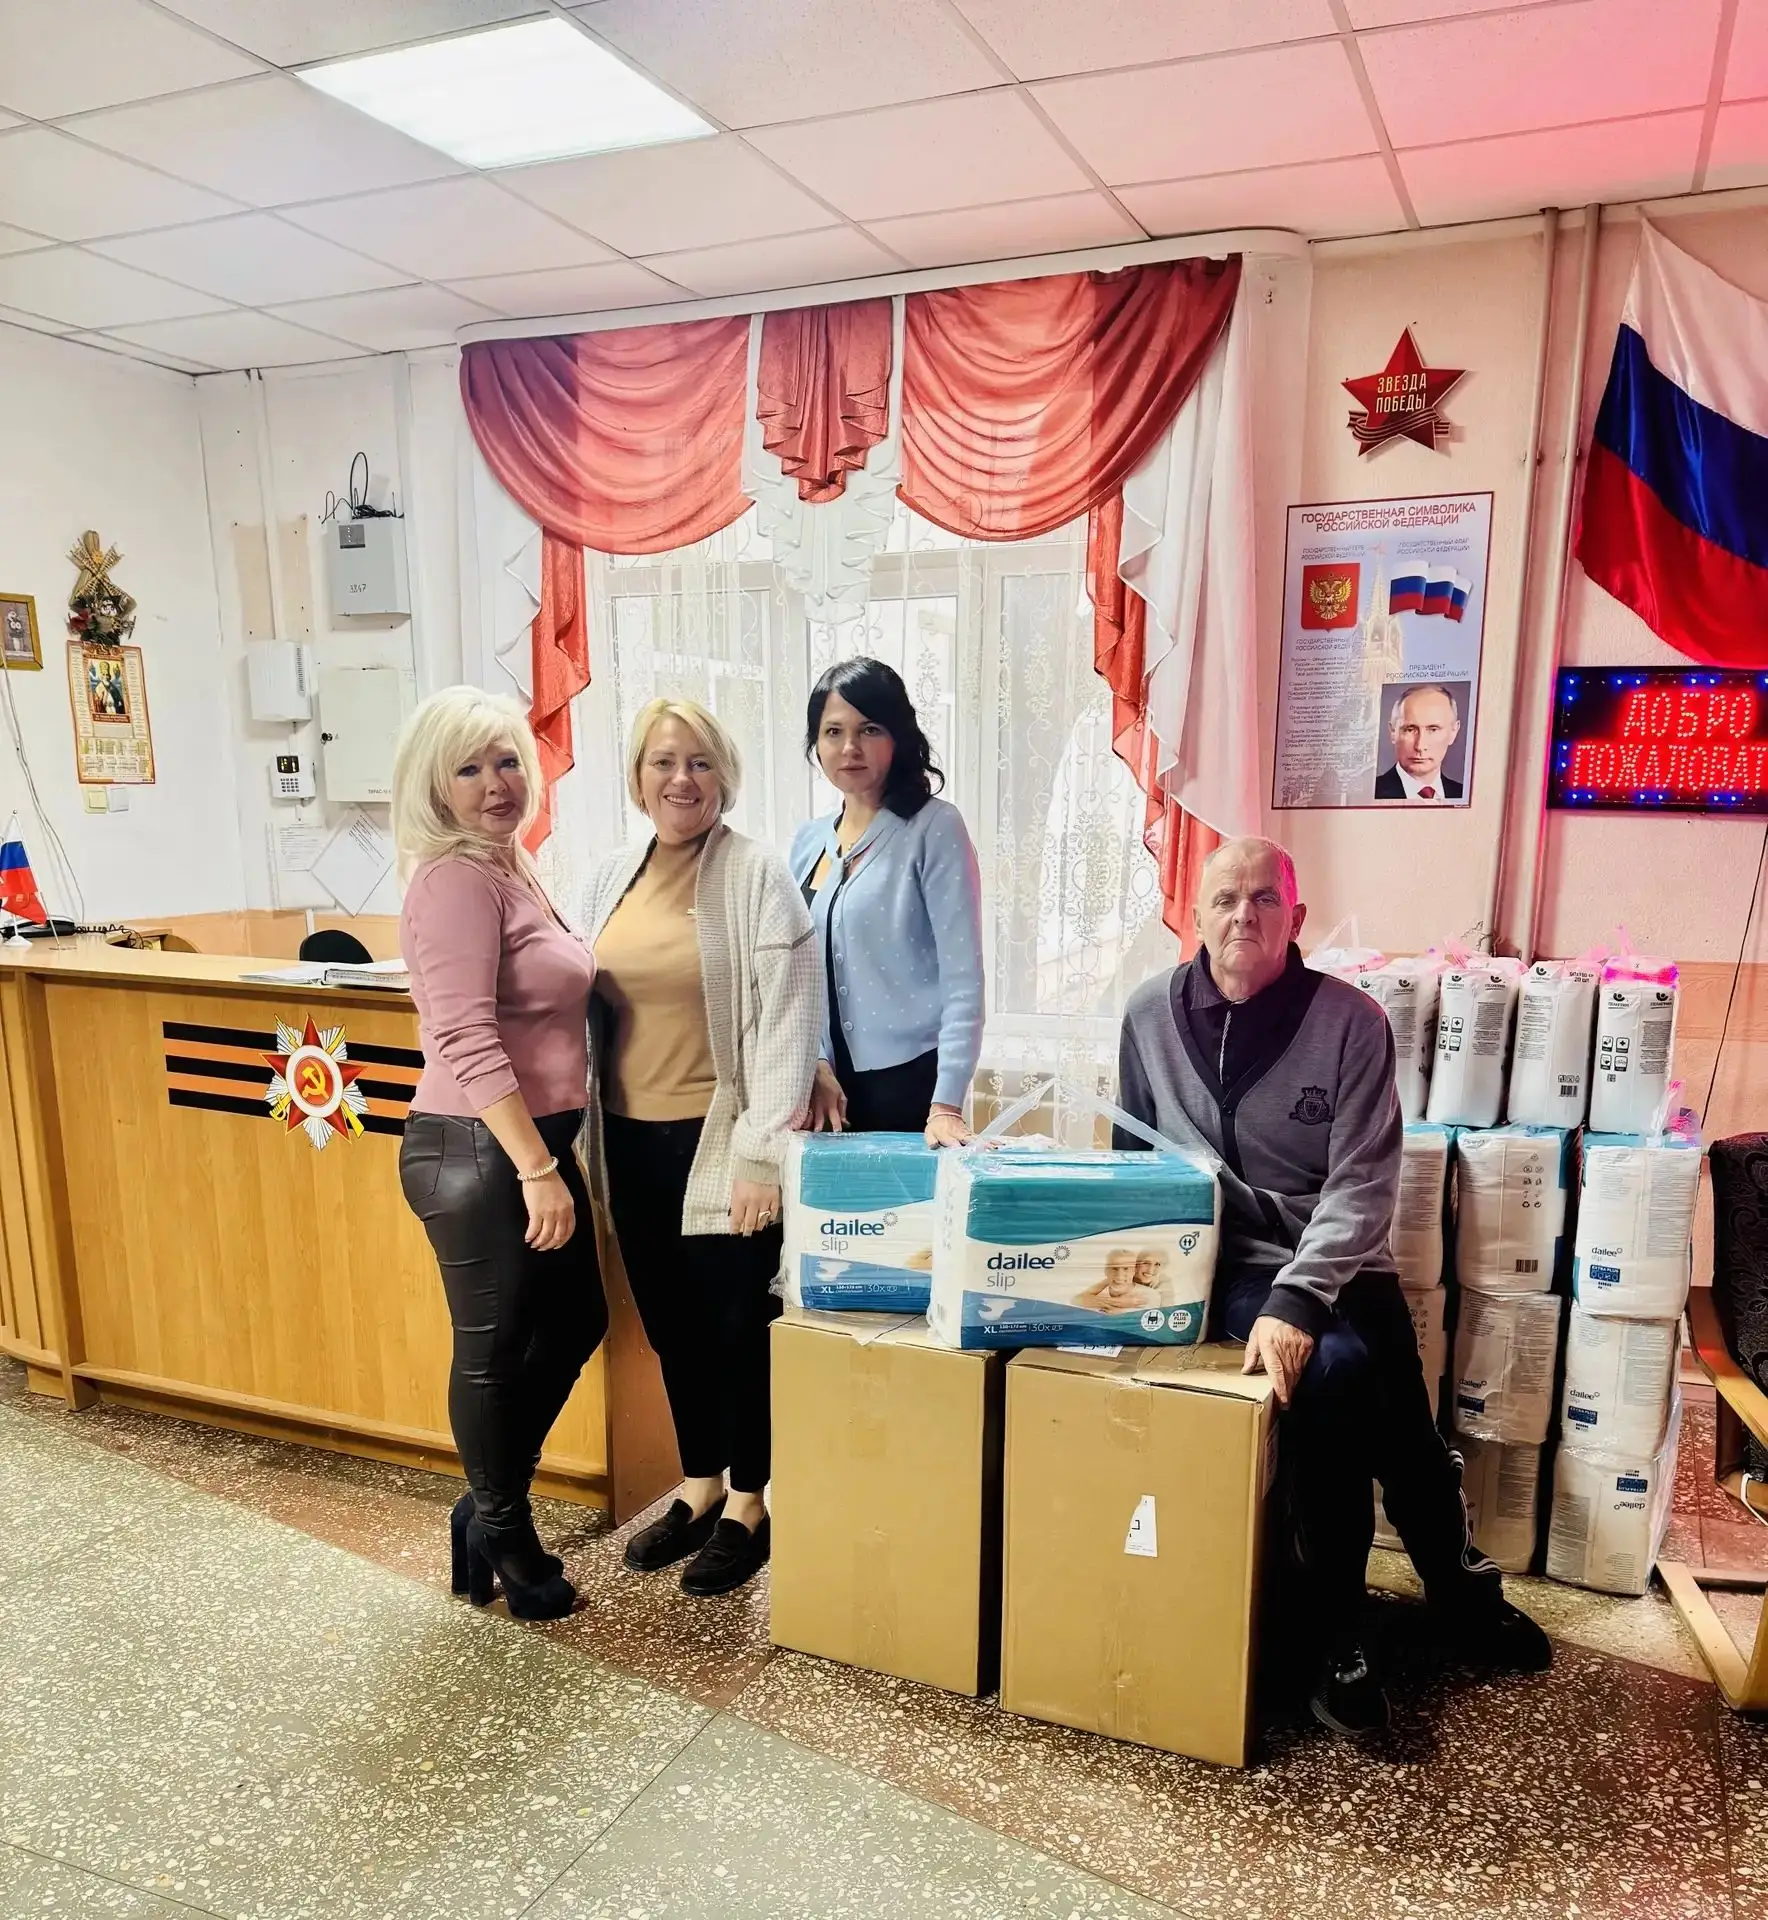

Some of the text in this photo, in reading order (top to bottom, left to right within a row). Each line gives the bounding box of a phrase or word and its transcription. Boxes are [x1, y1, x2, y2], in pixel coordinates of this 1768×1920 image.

[1377, 372, 1427, 394] ЗВЕЗДА
[1375, 393, 1426, 413] ПОБЕДЫ
[1301, 502, 1476, 524] ГОСУДАРСТВЕННАЯ СИМВОЛИКА
[1316, 515, 1459, 532] РОССИЙСКОЙ ФЕДЕРАЦИИ
[1409, 663, 1445, 671] ПРЕЗИДЕНТ
[1622, 691, 1752, 739] ДОБРО
[1571, 743, 1768, 792] ПОЖАЛОВАТ
[820, 1218, 885, 1236] dailee
[821, 1237, 849, 1254] slip
[1591, 1246, 1617, 1258] dailee
[987, 1252, 1055, 1270] dailee
[820, 1285, 834, 1294] XL
[867, 1283, 886, 1293] 30x
[986, 1271, 1016, 1292] slip
[983, 1325, 998, 1334] XL
[1031, 1322, 1050, 1332] 30x
[1569, 1389, 1595, 1400] dailee
[1619, 1501, 1646, 1510] dailee
